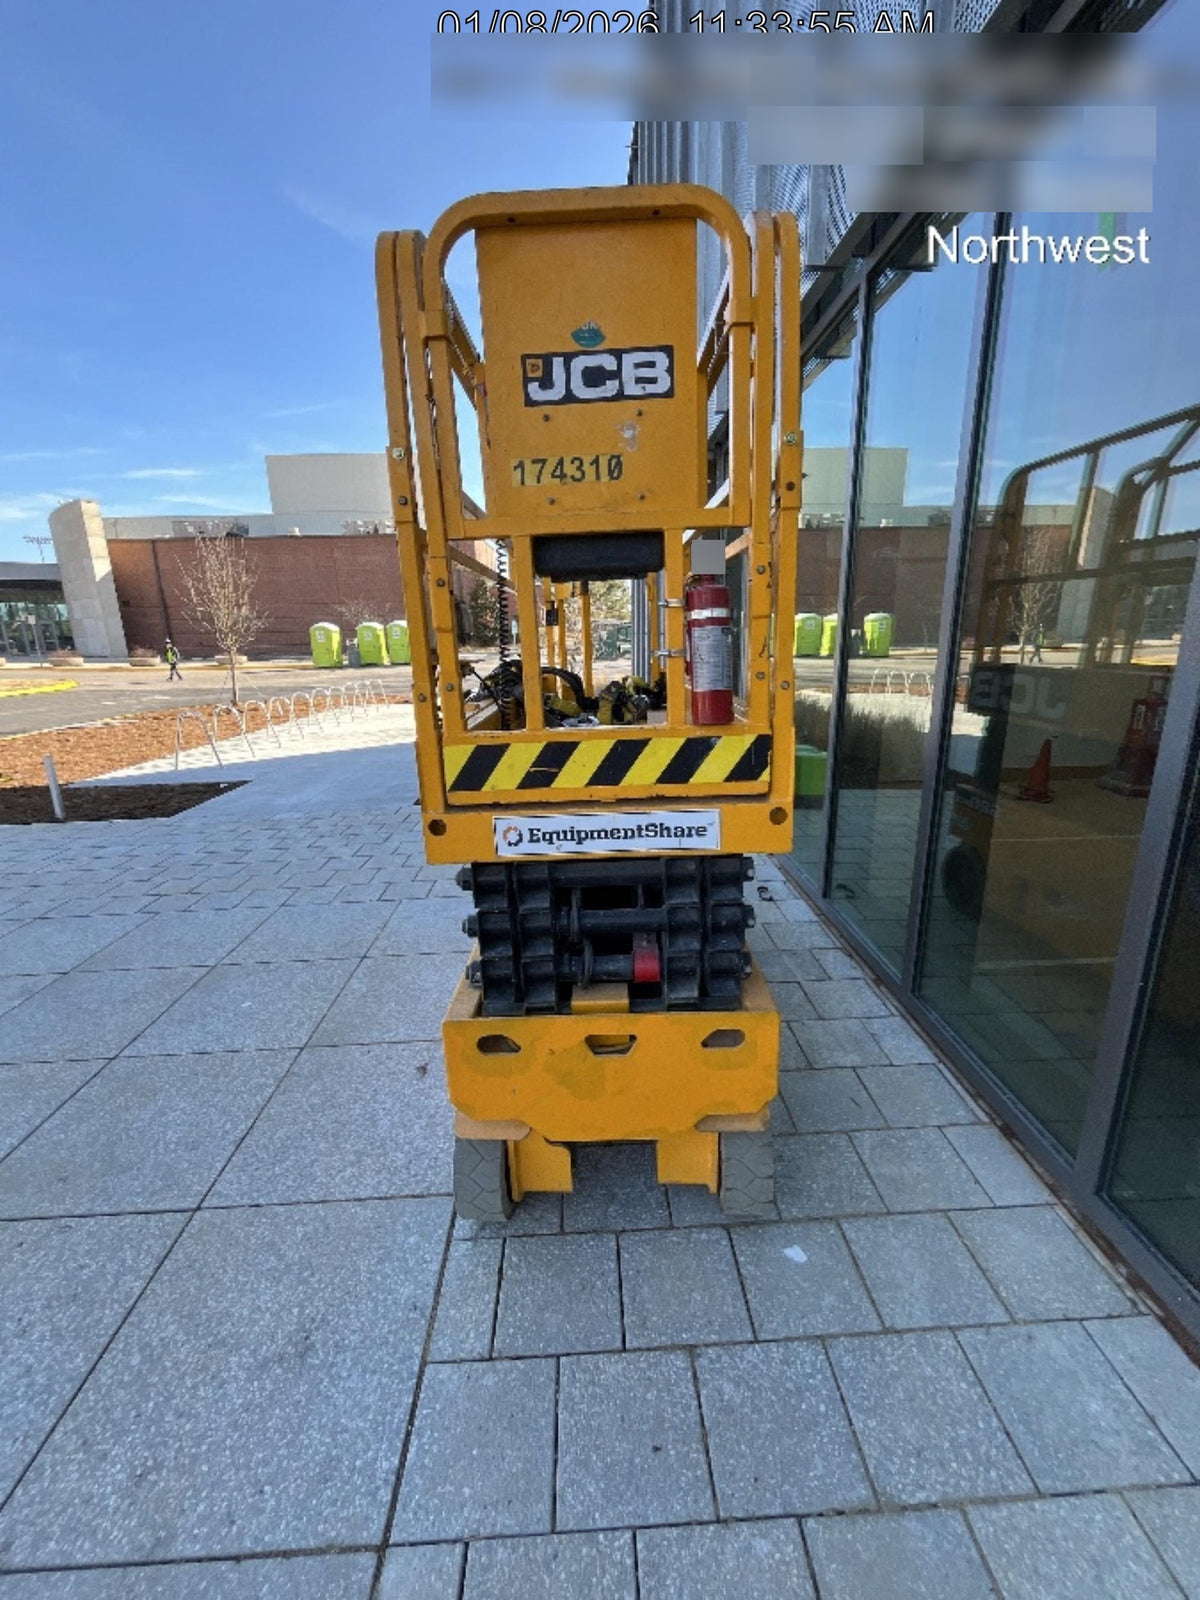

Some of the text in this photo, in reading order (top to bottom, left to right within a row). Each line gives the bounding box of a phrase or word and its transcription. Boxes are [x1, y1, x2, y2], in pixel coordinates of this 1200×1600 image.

[527, 351, 672, 401] JCB
[513, 454, 623, 486] 174310
[527, 822, 708, 846] EquipmentShare
